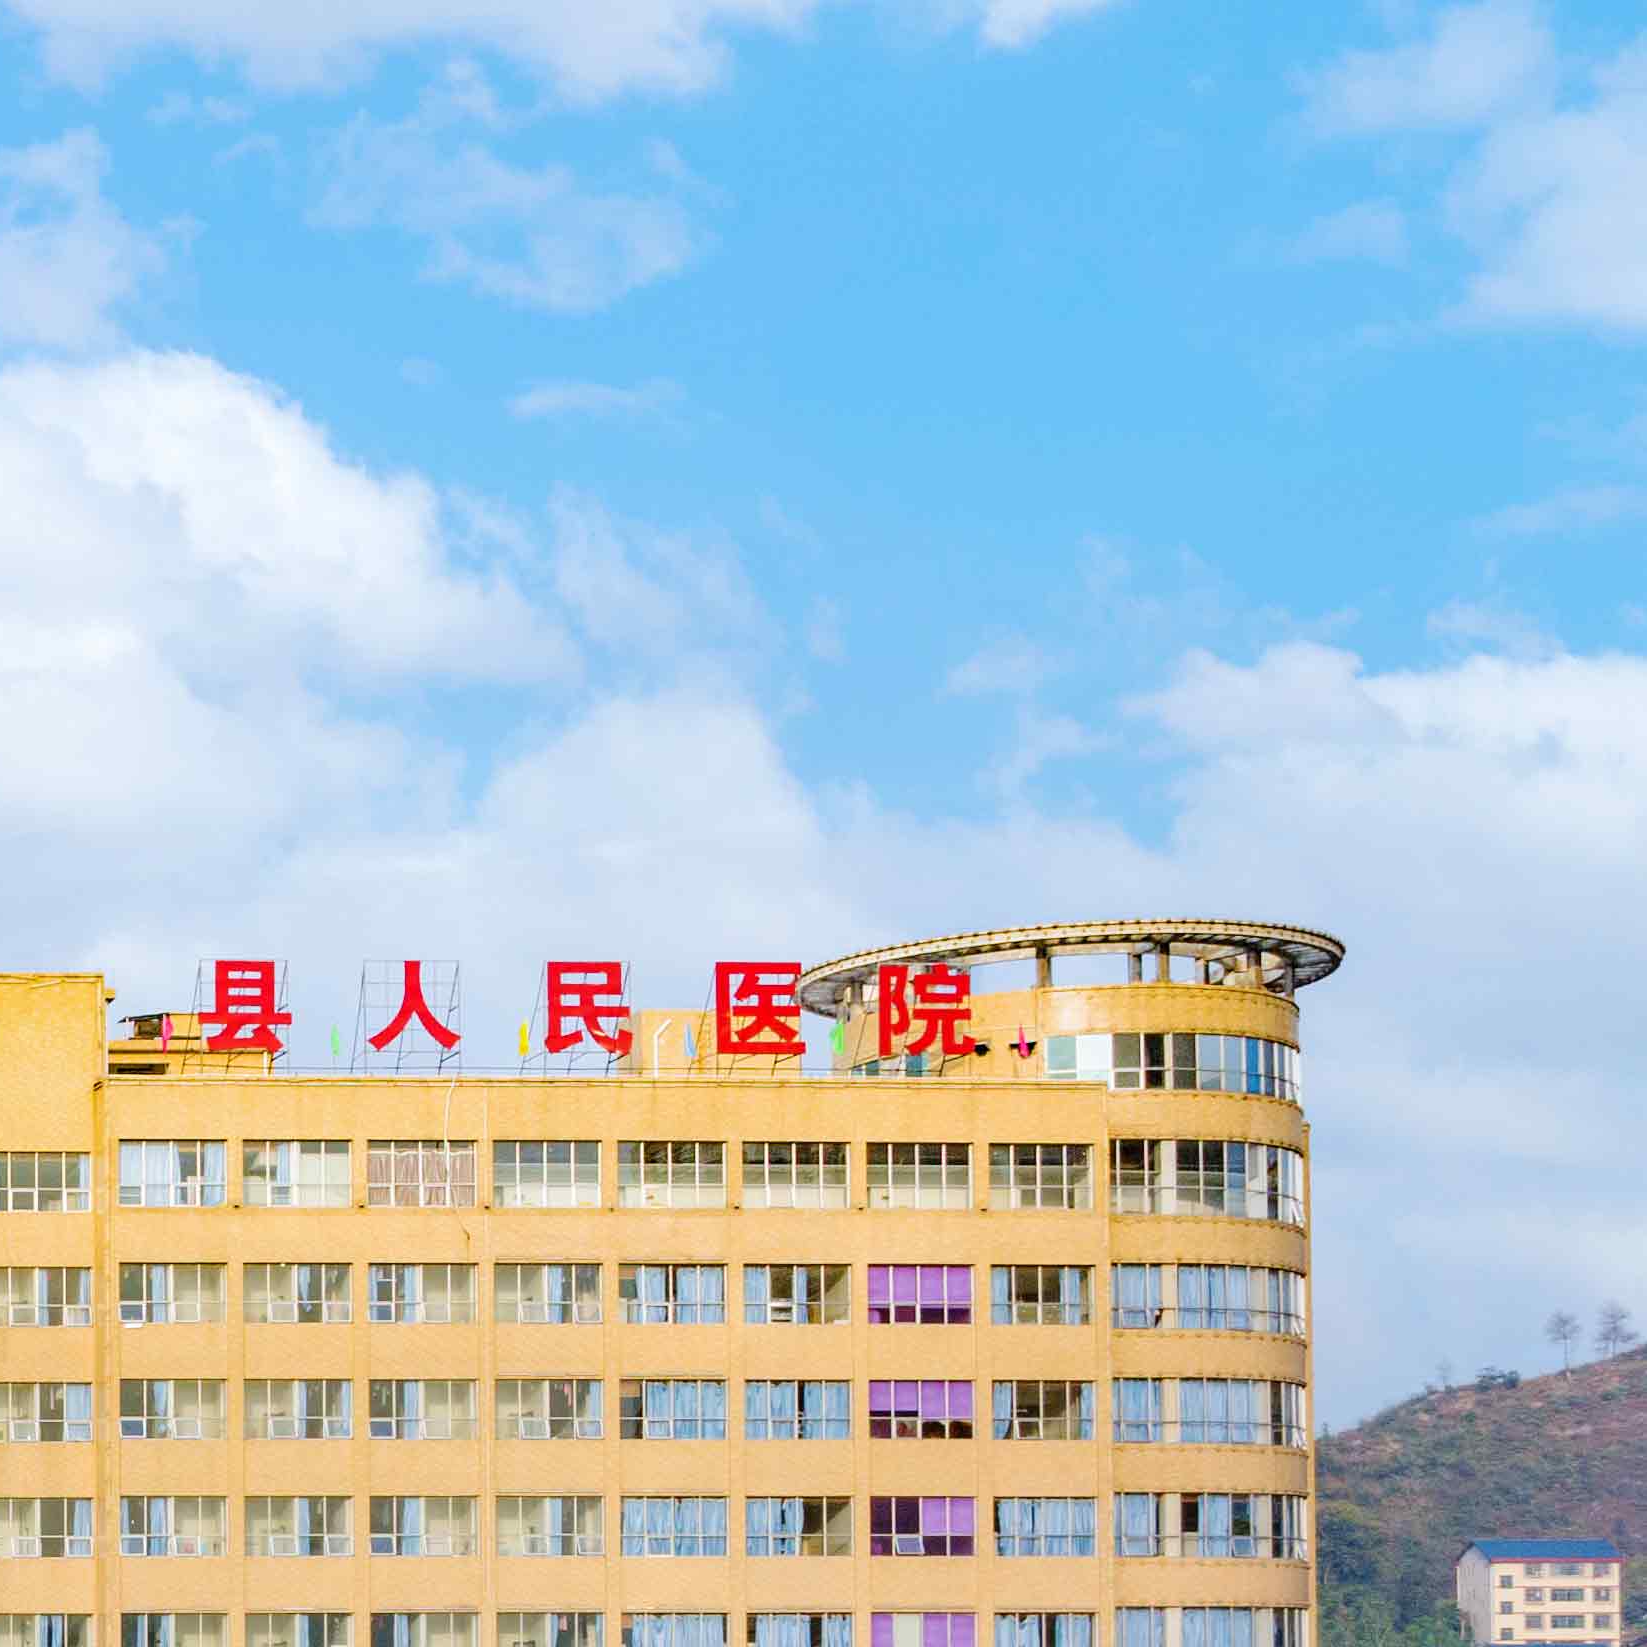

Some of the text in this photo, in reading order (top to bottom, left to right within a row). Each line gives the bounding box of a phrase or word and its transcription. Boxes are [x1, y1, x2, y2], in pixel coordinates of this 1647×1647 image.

[198, 959, 977, 1057] 县人民医院
